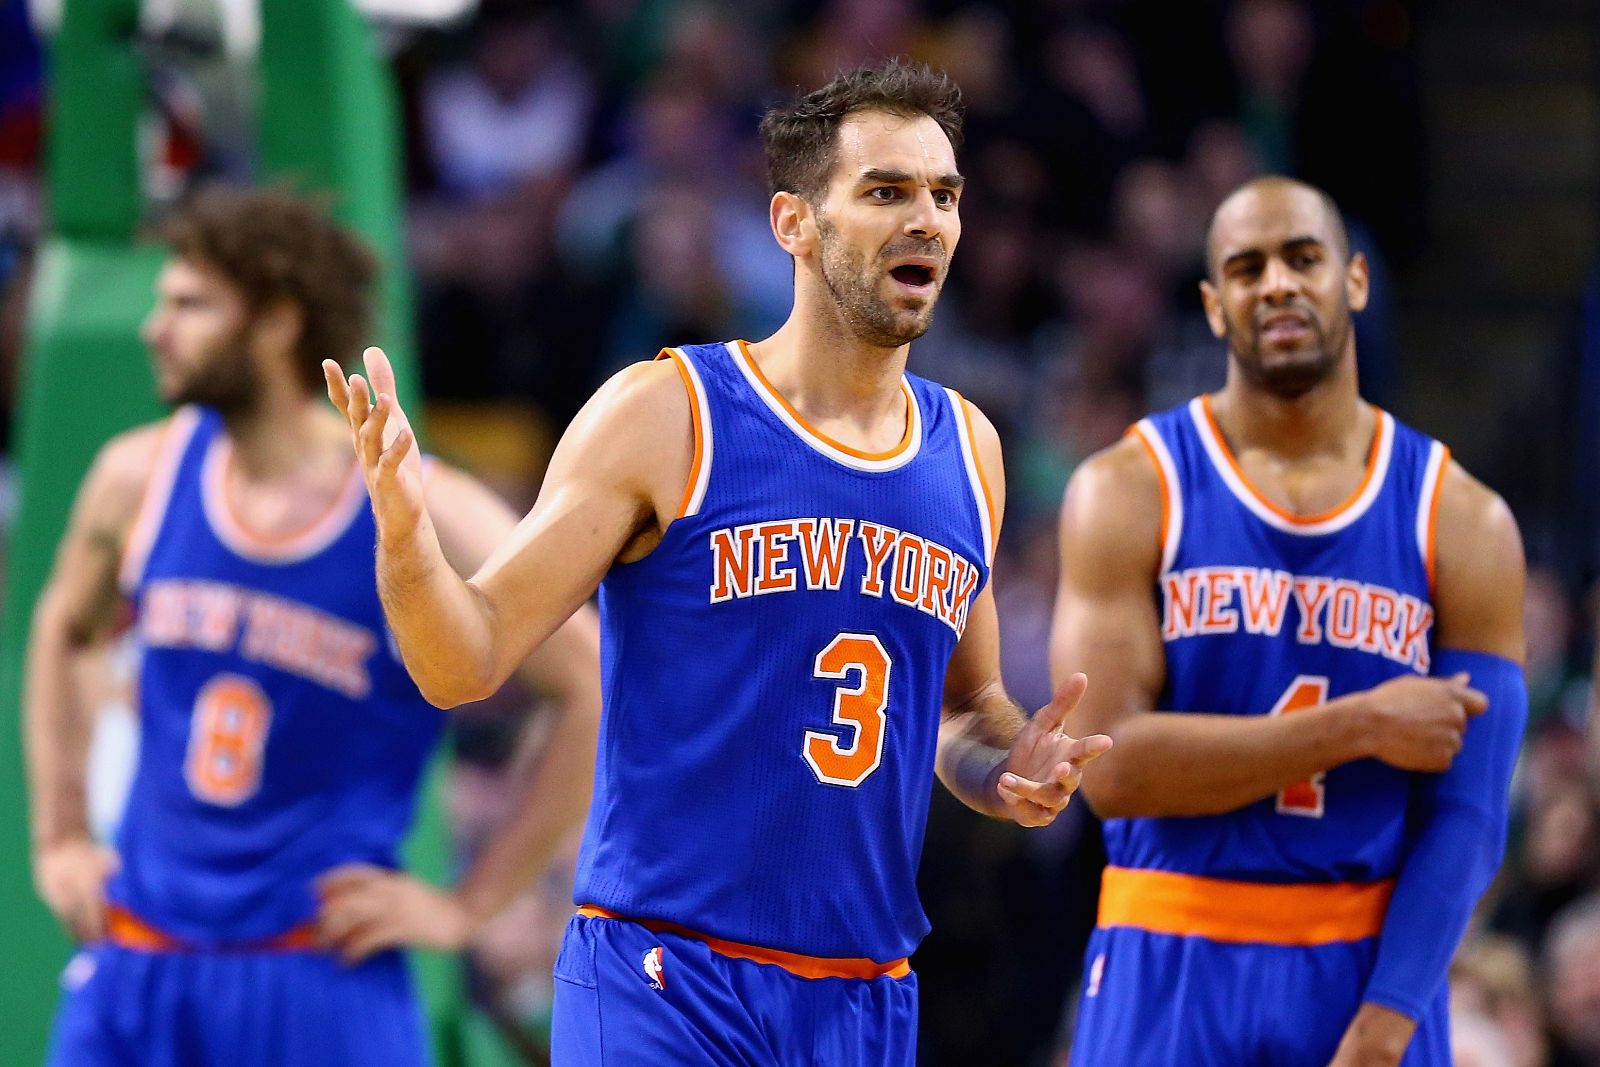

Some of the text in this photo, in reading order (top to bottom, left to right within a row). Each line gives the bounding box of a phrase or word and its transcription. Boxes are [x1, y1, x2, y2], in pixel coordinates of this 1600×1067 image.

[710, 518, 979, 642] NEW YORK
[1161, 566, 1433, 675] NEW YORK
[184, 672, 274, 807] 8
[803, 633, 892, 787] 3
